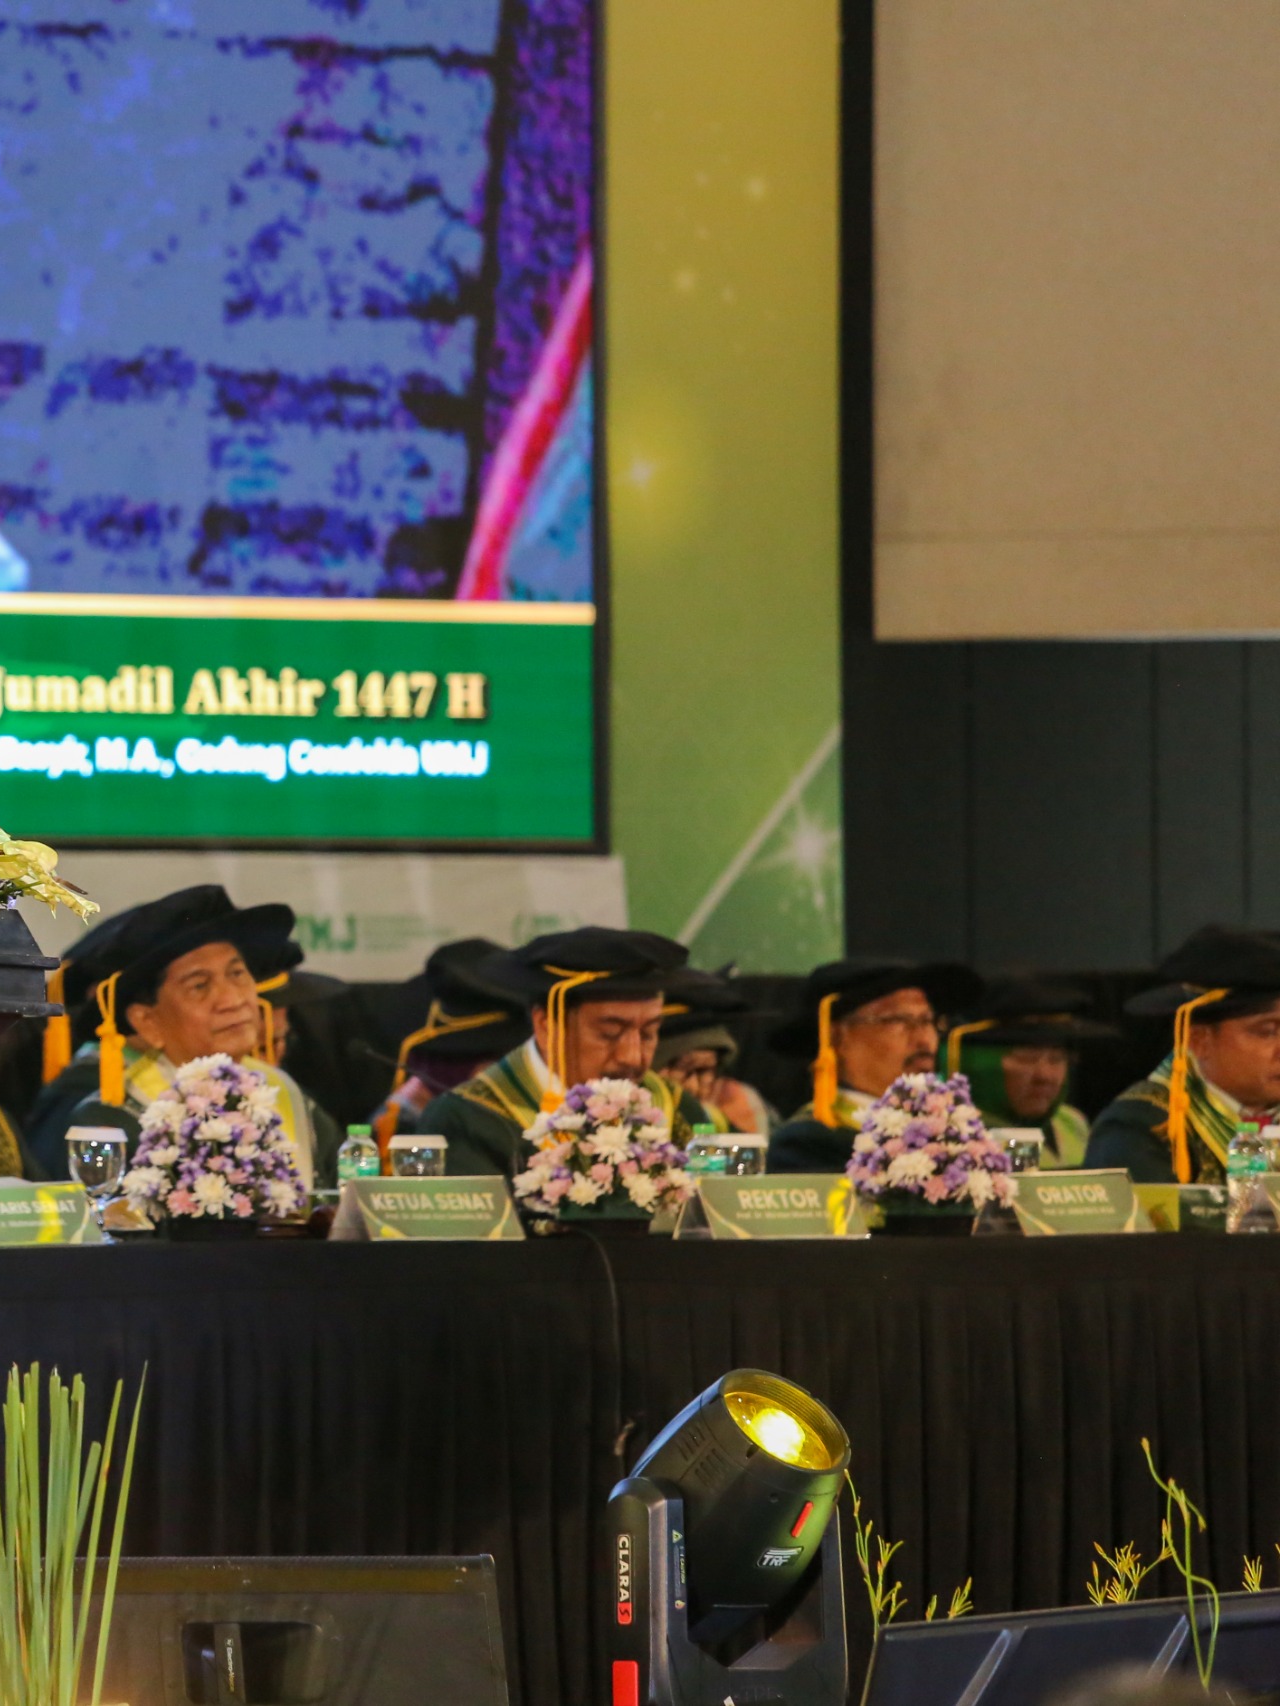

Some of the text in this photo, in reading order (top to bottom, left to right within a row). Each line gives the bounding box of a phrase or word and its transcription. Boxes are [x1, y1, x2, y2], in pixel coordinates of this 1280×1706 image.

[183, 666, 325, 717] Akhir
[333, 669, 437, 718] 1447
[445, 671, 487, 720] H
[371, 1192, 495, 1211] KETUA SENAT
[736, 1188, 820, 1210] REKTOR
[1036, 1183, 1109, 1204] ORATOR
[618, 1536, 630, 1602] CLARA
